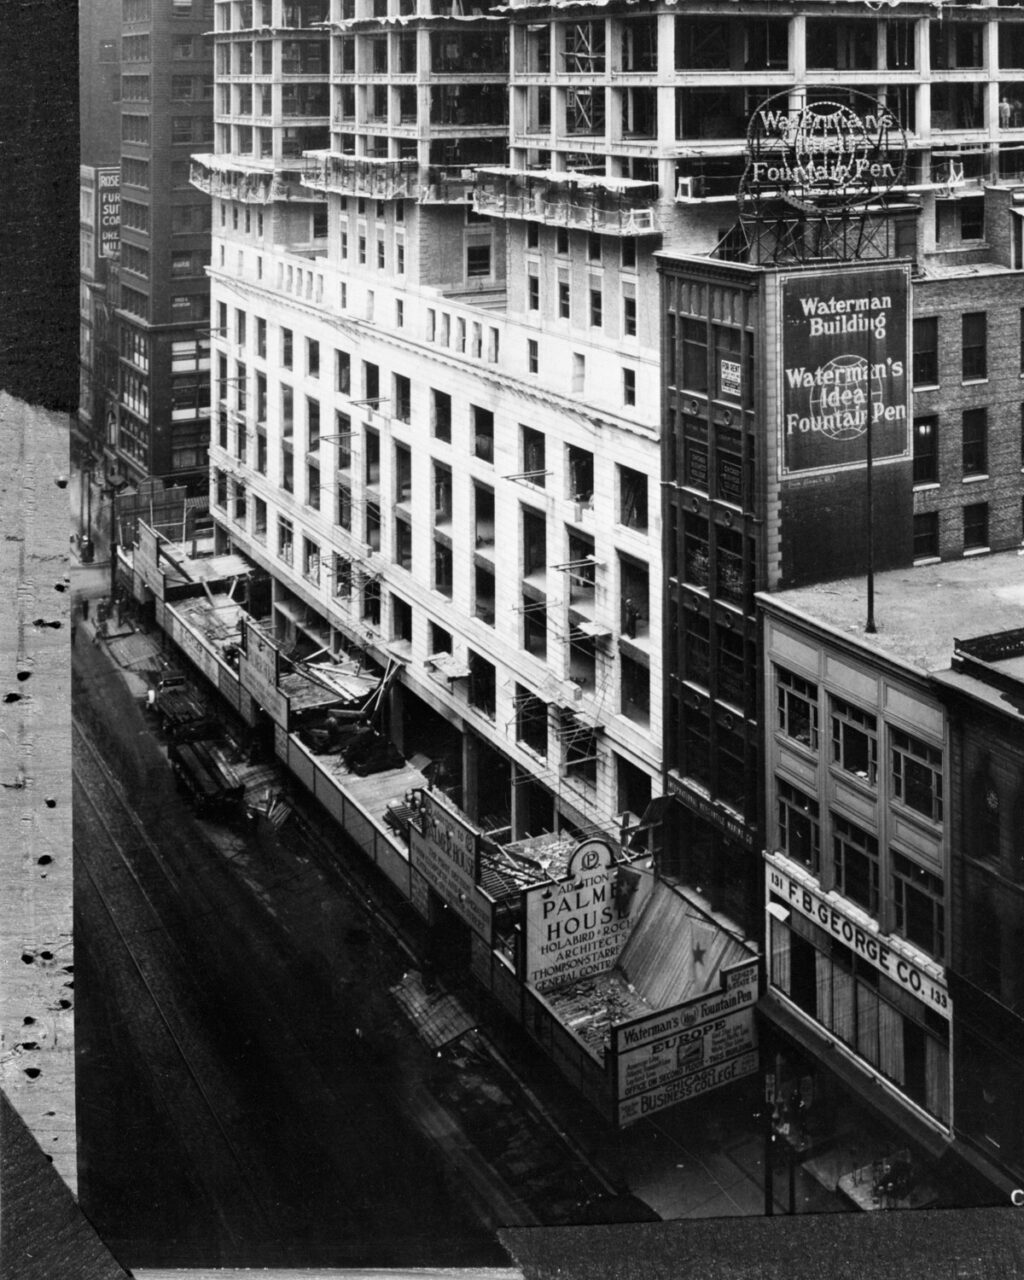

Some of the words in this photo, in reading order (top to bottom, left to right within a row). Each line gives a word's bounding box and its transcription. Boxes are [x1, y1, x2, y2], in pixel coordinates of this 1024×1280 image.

[753, 160, 850, 183] Fountain
[855, 158, 896, 179] Pen
[800, 296, 891, 317] Waterman
[810, 312, 886, 339] Building
[785, 357, 904, 388] Waterman's
[822, 386, 866, 408] Idea
[873, 402, 907, 423] Pen
[543, 882, 618, 919] PALME
[541, 930, 595, 955] HOLABIRD
[556, 933, 627, 962] ARCHITECTS
[771, 873, 783, 890] 131
[818, 904, 890, 971] GEORGE
[897, 960, 925, 995] CO.
[930, 987, 948, 1008] 133
[624, 1018, 679, 1045] Waterman's
[700, 995, 737, 1018] Fountain
[736, 989, 752, 1005] Pen
[652, 1020, 727, 1055] EUROPE
[641, 1087, 692, 1114] BUSINESS
[695, 1060, 739, 1092] COLLEGE
[665, 1068, 715, 1092] CHICAGO
